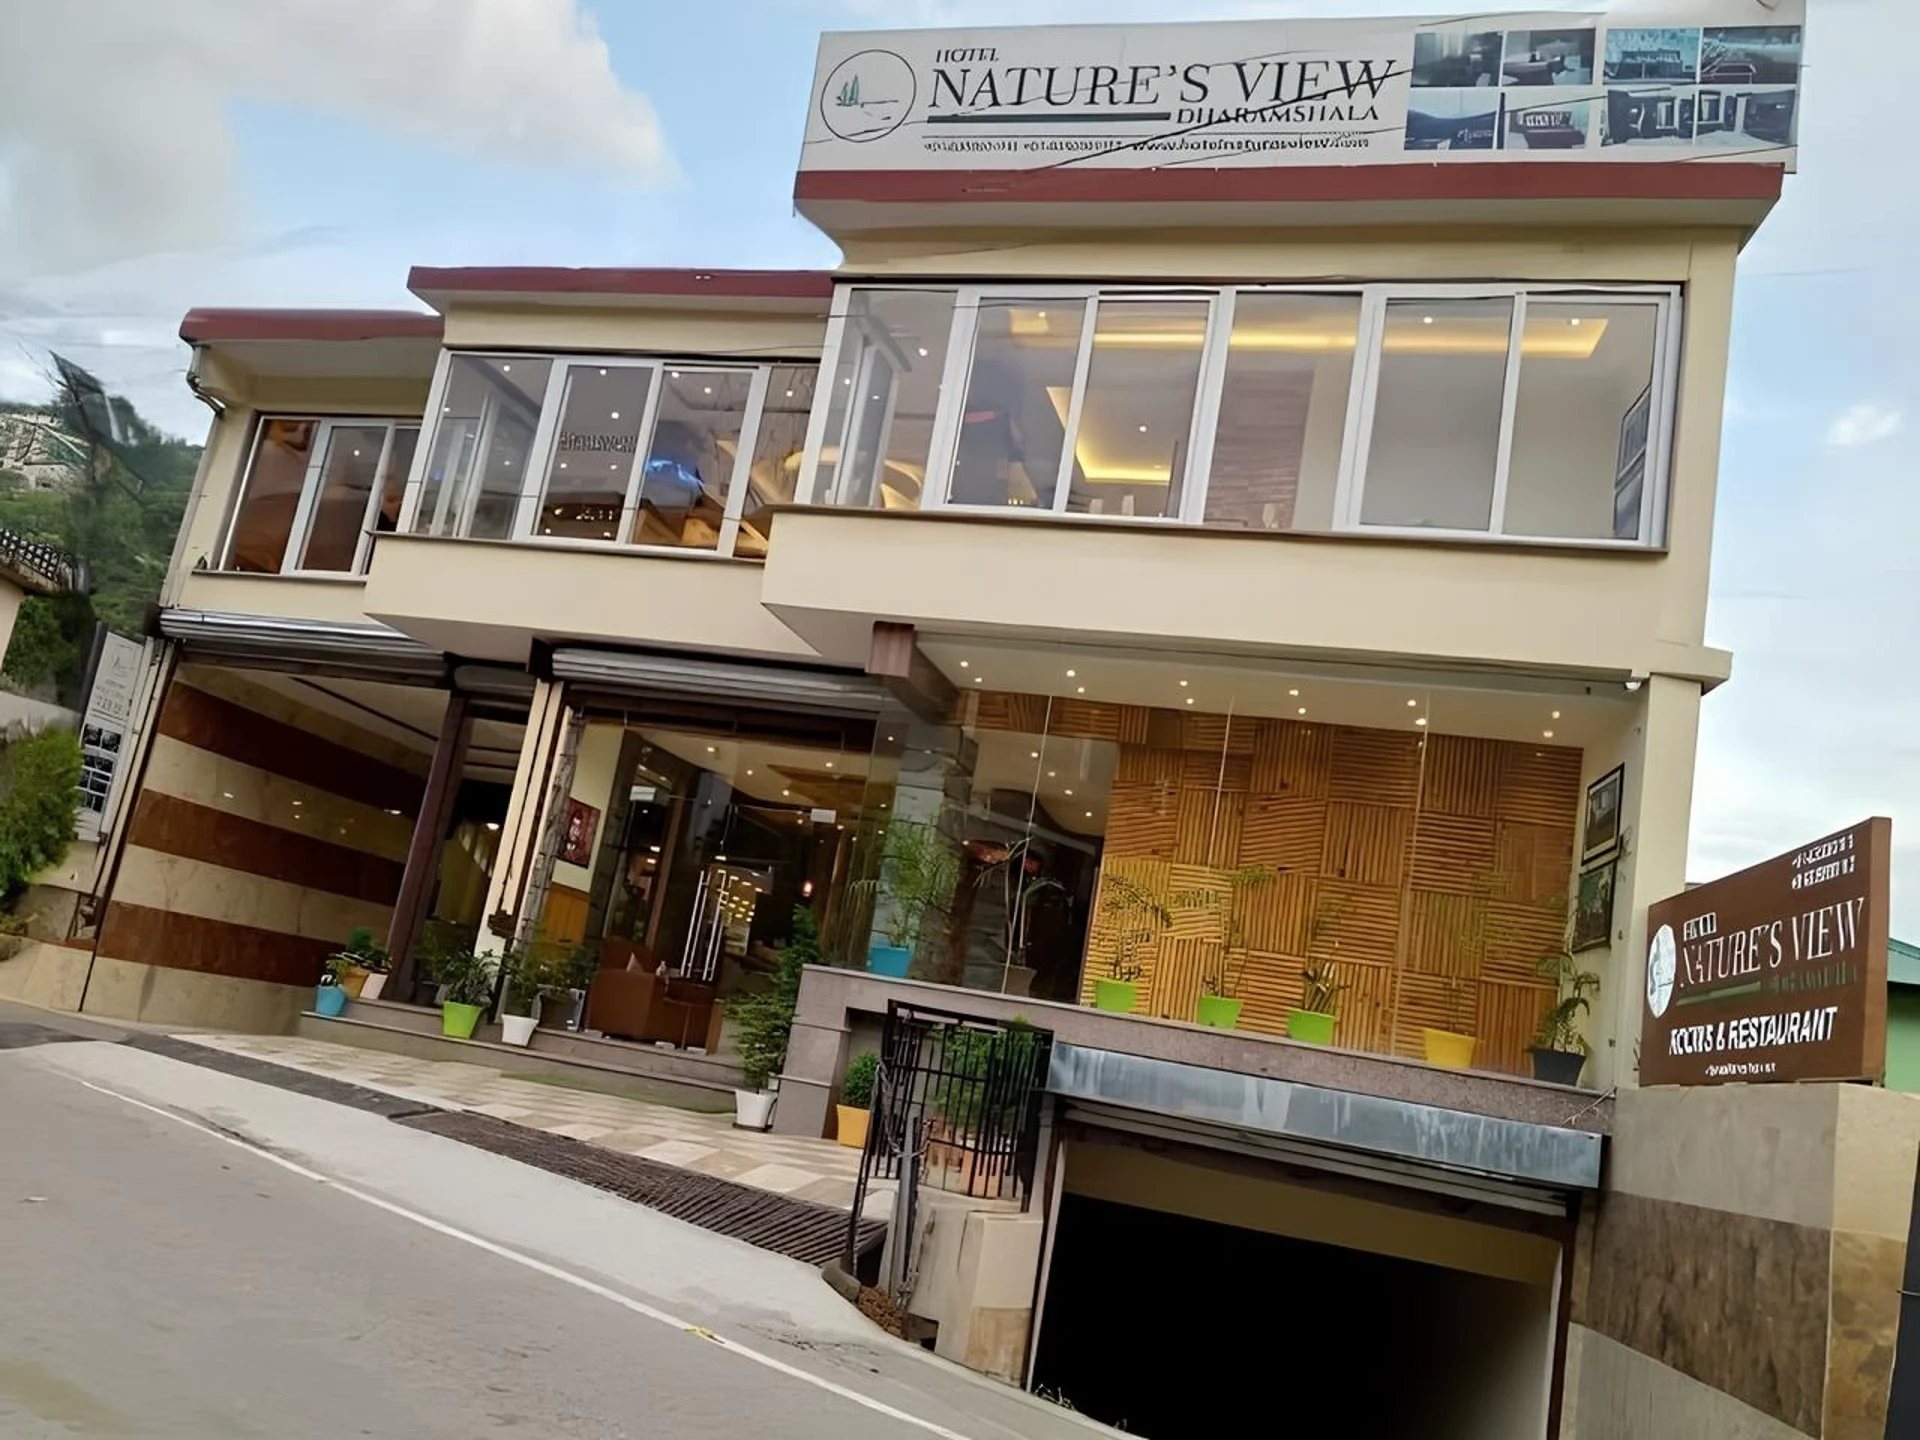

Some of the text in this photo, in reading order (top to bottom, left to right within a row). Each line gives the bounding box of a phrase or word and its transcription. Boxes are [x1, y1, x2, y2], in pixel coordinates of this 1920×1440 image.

[928, 60, 1397, 108] NATURE'S VIEW
[1176, 105, 1379, 124] DHARAMSHALA
[1680, 920, 1783, 988] NATURE'S
[1791, 897, 1864, 961] VIEW
[1728, 1006, 1838, 1049] RESTAURANT
